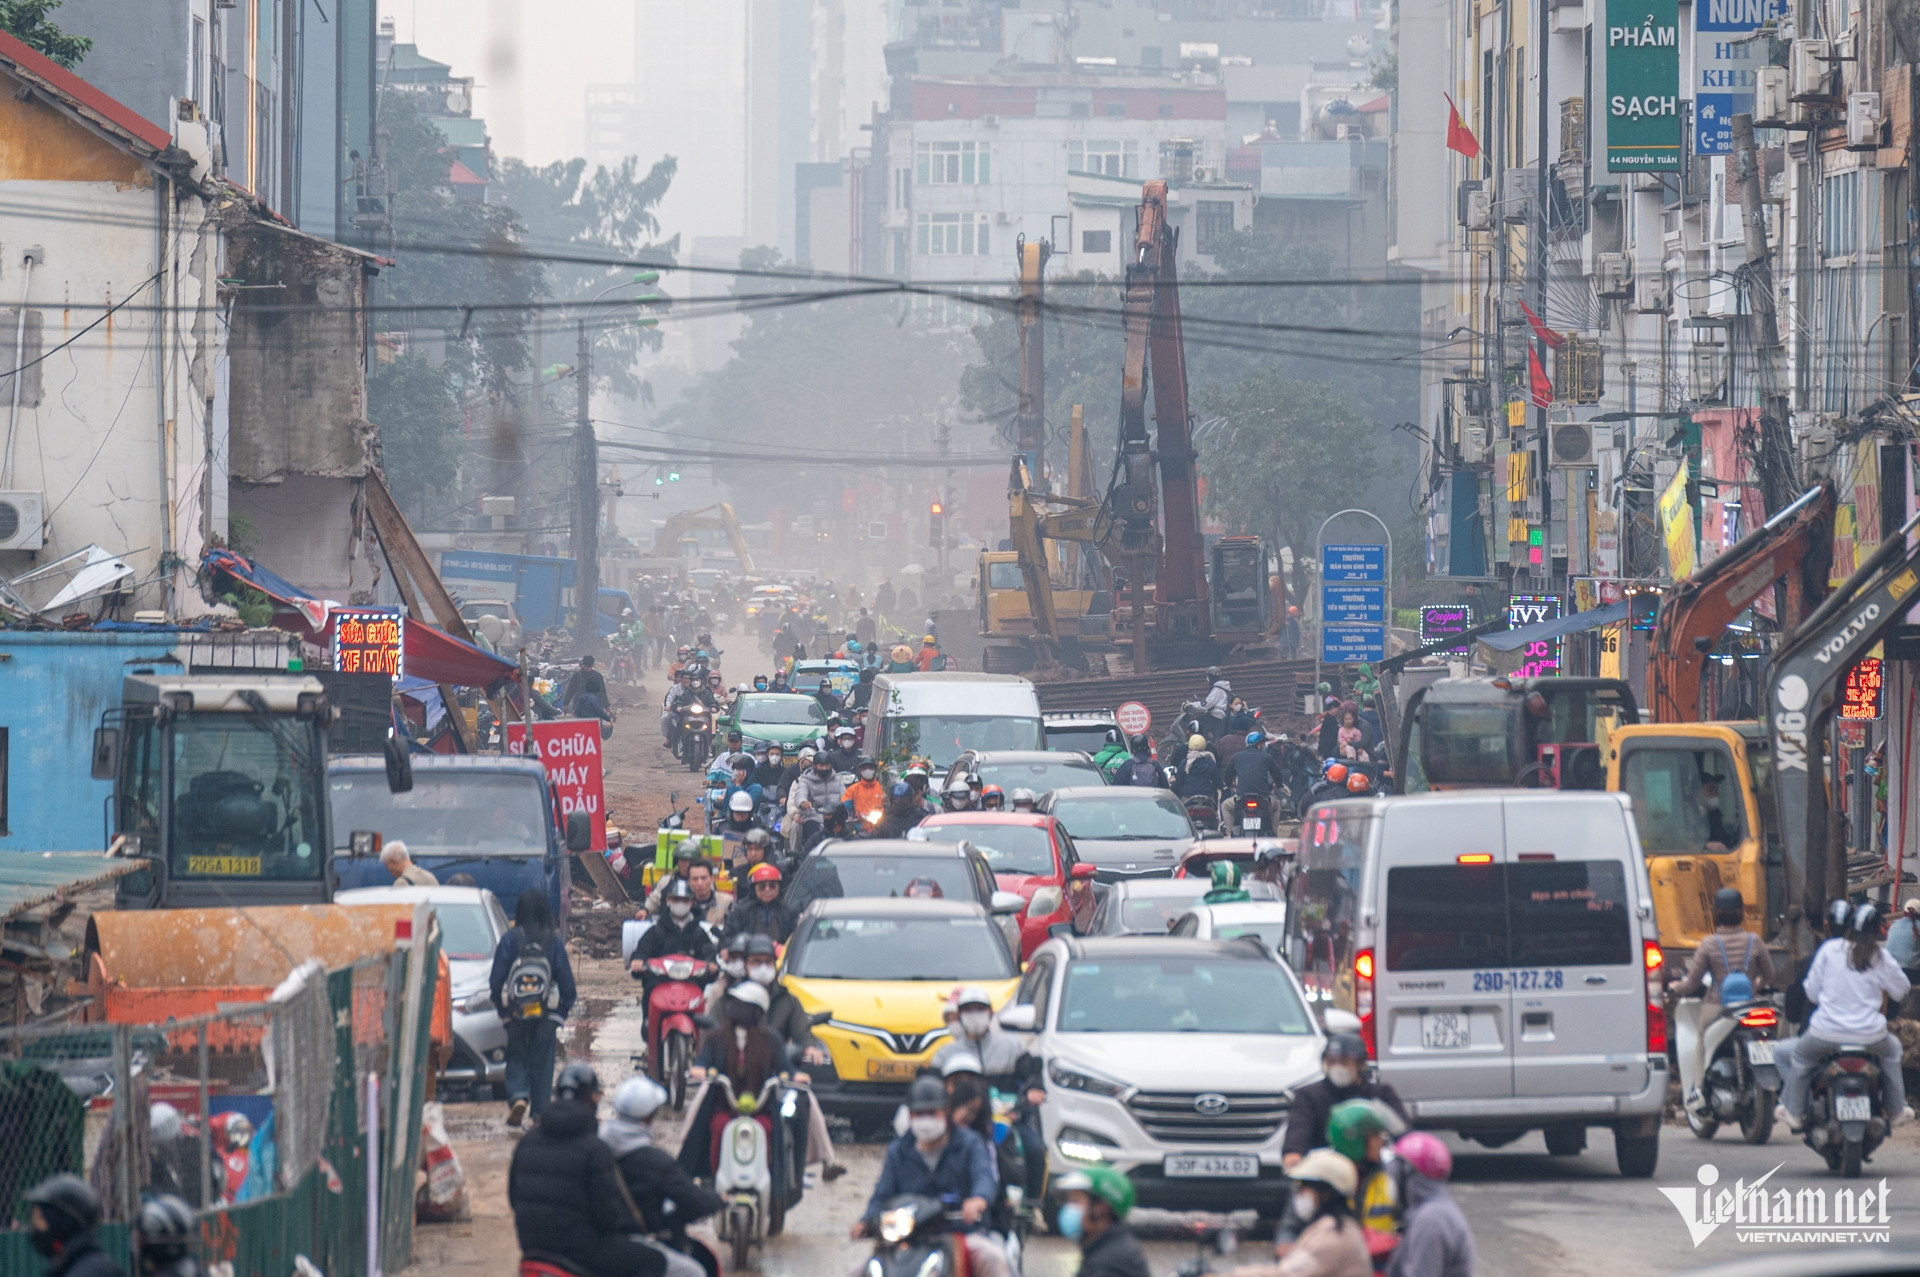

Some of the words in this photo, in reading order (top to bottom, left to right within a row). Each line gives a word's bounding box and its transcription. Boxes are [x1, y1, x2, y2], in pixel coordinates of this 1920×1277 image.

[1610, 14, 1675, 46] PHẨM
[1611, 95, 1676, 121] SẠCH
[1657, 155, 1678, 163] TUÂN
[1511, 605, 1548, 623] IVY
[340, 618, 364, 644] SỬA
[366, 619, 398, 644] CHỮA
[1814, 603, 1880, 664] VOLVO
[547, 732, 597, 757] CHỮA
[551, 761, 589, 786] MÁY
[561, 786, 598, 814] DẦU
[1473, 970, 1564, 991] 29D-127.28
